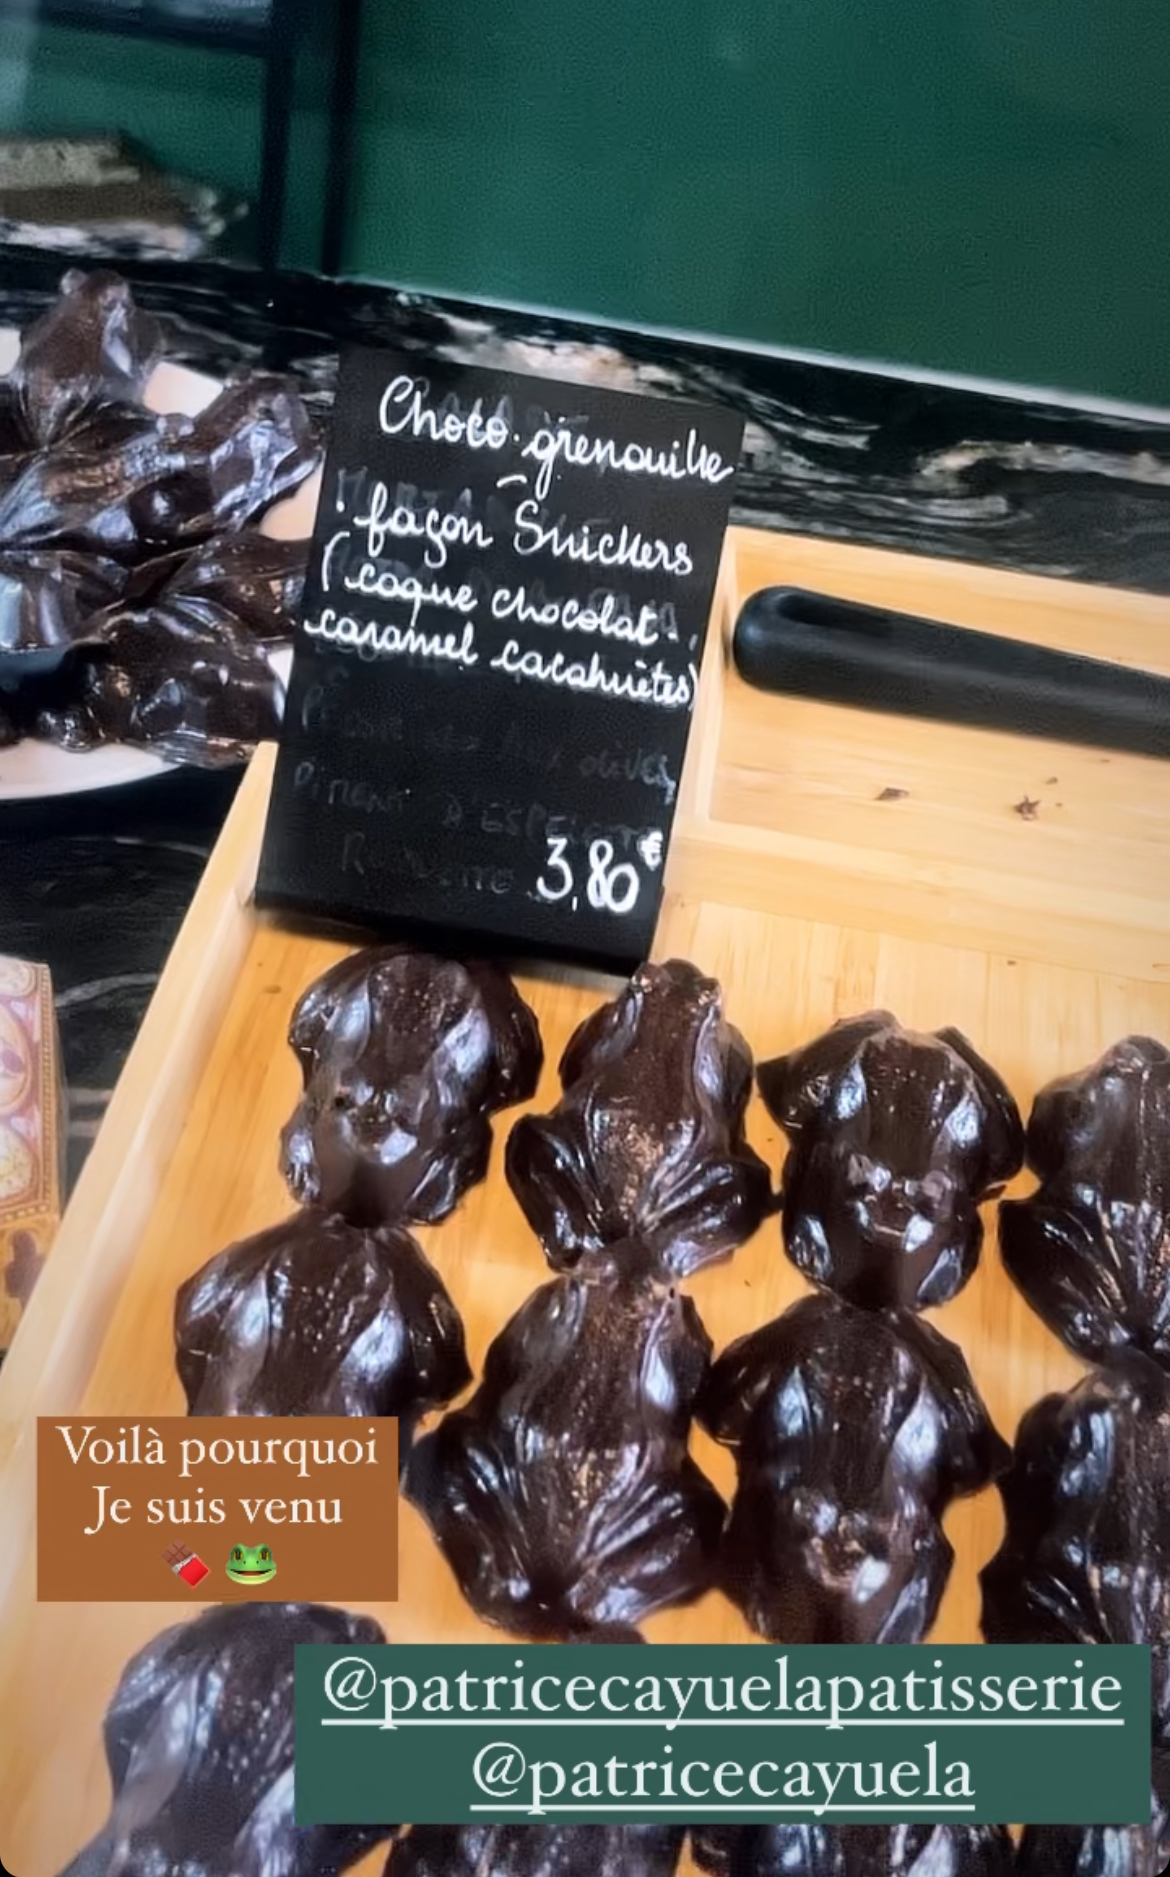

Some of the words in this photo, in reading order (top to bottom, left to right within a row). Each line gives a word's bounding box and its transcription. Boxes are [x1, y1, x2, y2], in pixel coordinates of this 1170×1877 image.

[353, 482, 494, 568] façon
[513, 499, 694, 576] Snickers
[303, 608, 479, 667] caramel
